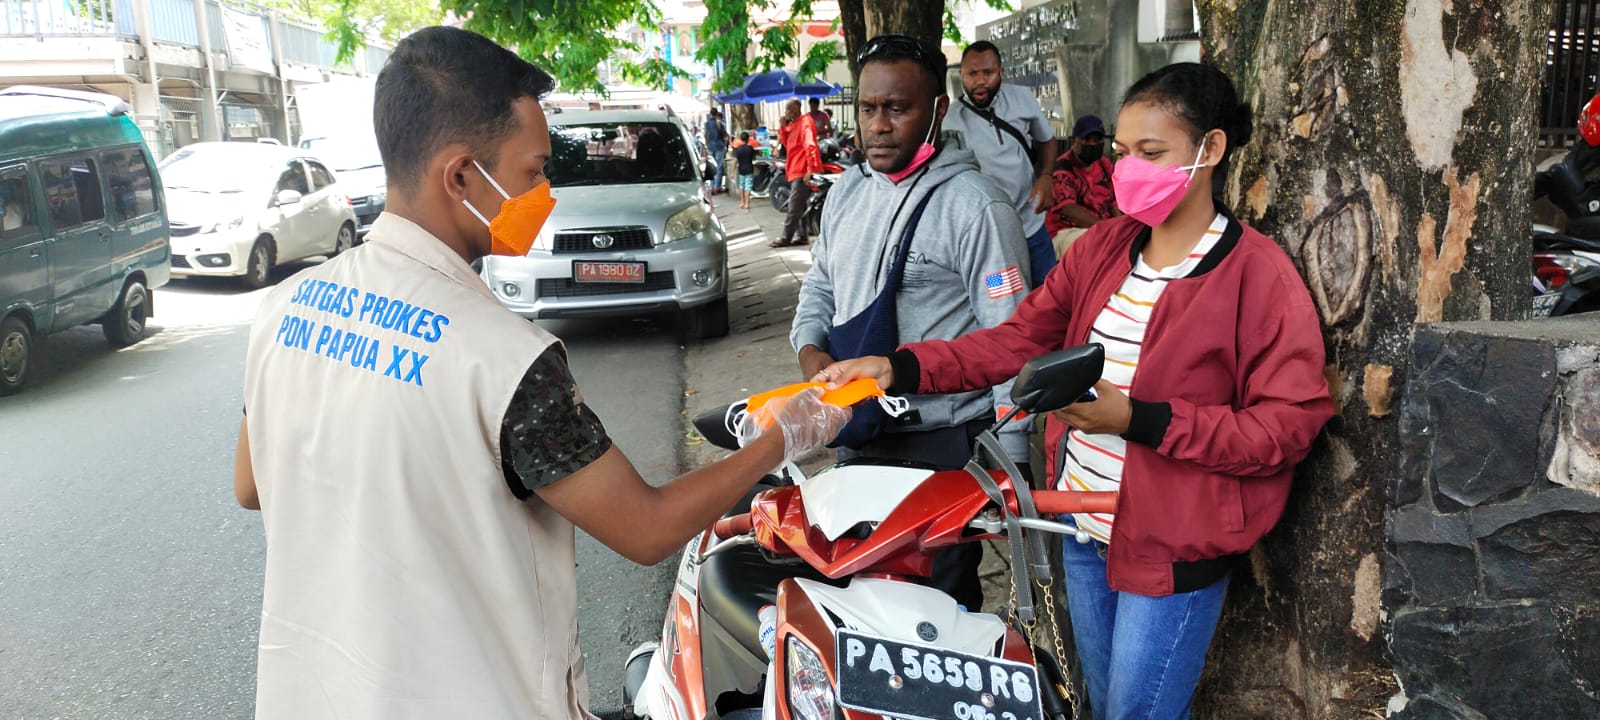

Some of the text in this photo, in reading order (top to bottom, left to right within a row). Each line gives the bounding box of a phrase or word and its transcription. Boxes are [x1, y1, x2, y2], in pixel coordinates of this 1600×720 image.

[582, 263, 596, 276] PA
[599, 263, 624, 276] 1980
[291, 278, 450, 343] SATGAS PROKES
[275, 314, 429, 387] PON PAPUA XX
[846, 638, 896, 675] PA
[901, 647, 983, 692] 5659
